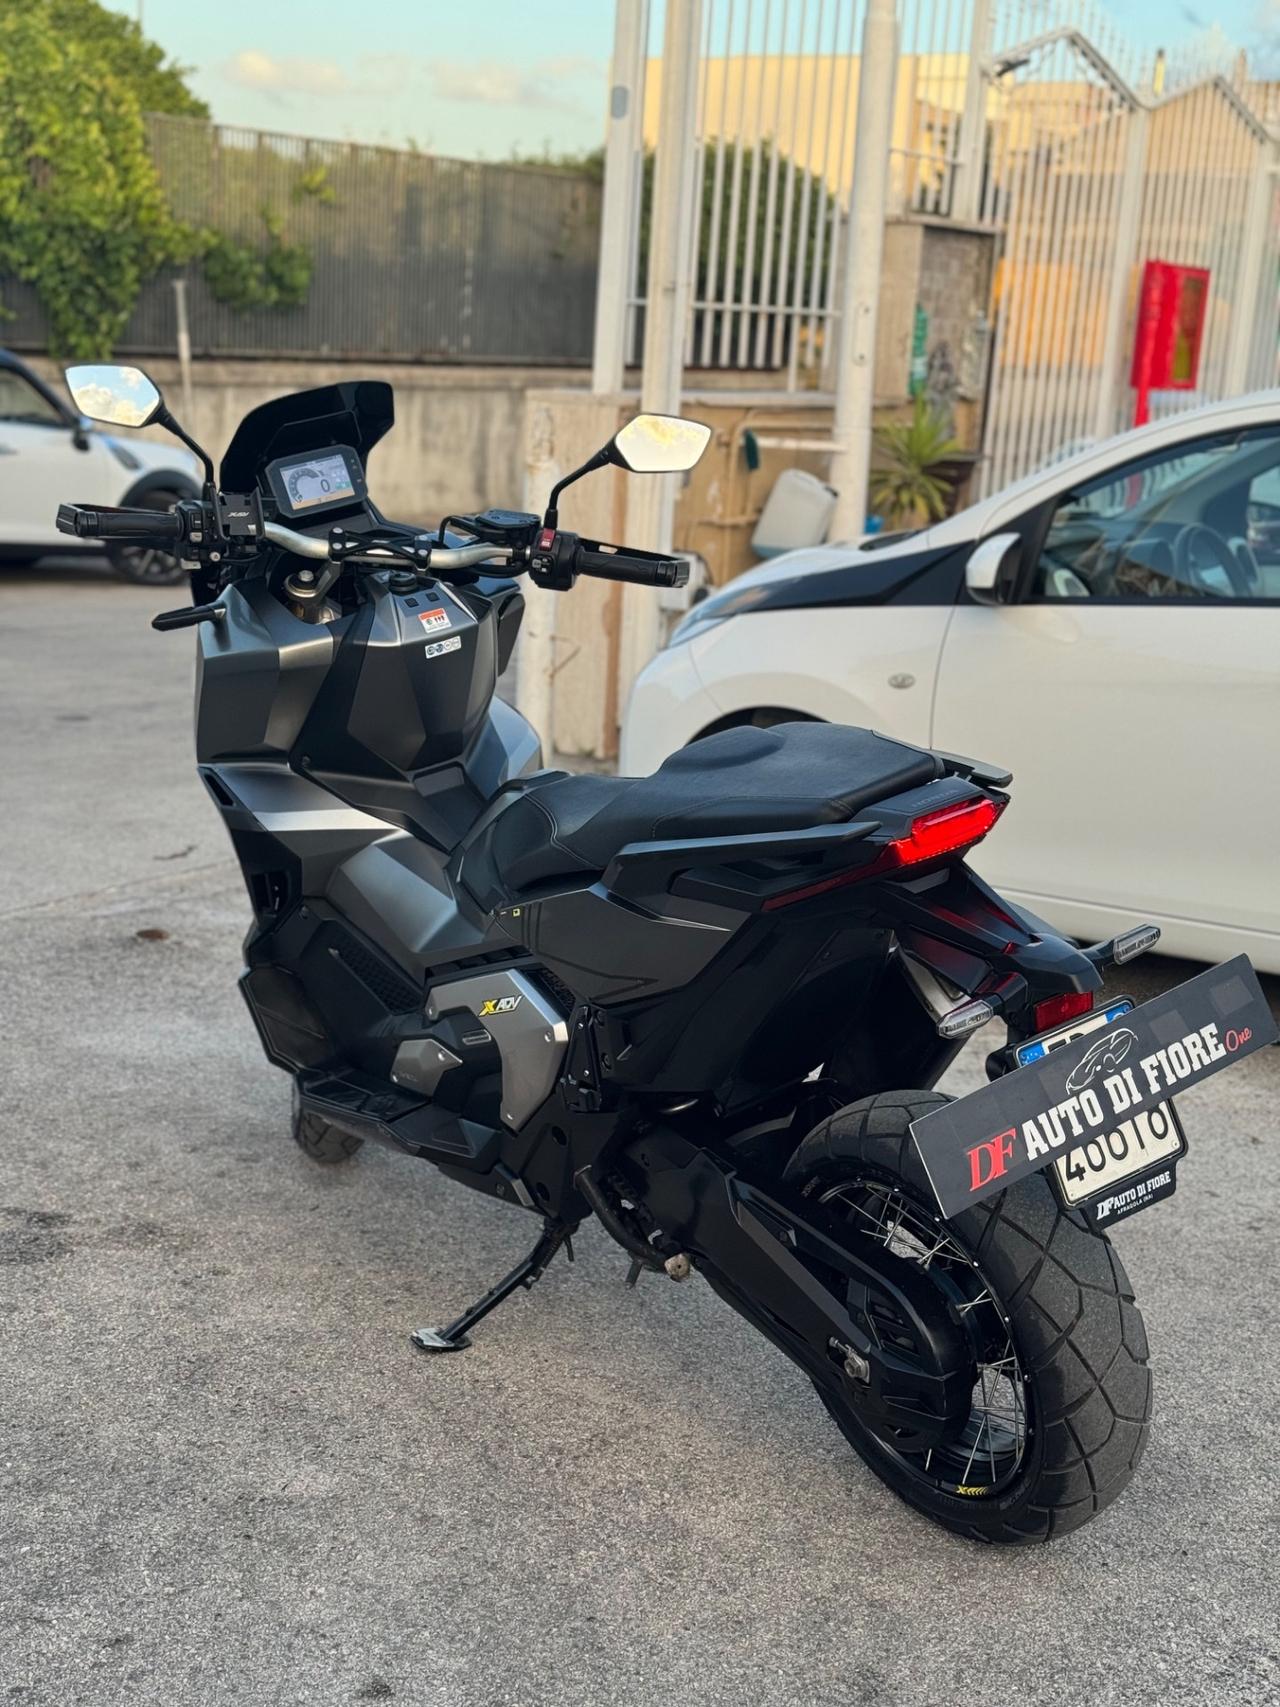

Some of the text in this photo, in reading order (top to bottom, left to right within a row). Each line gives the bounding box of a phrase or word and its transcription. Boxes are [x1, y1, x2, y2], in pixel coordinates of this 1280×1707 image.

[966, 1022, 1253, 1191] DF AUTO DI FIORE One
[1113, 1188, 1137, 1209] AUTO
[1136, 1183, 1147, 1197] DI
[1146, 1170, 1171, 1192] FIORE
